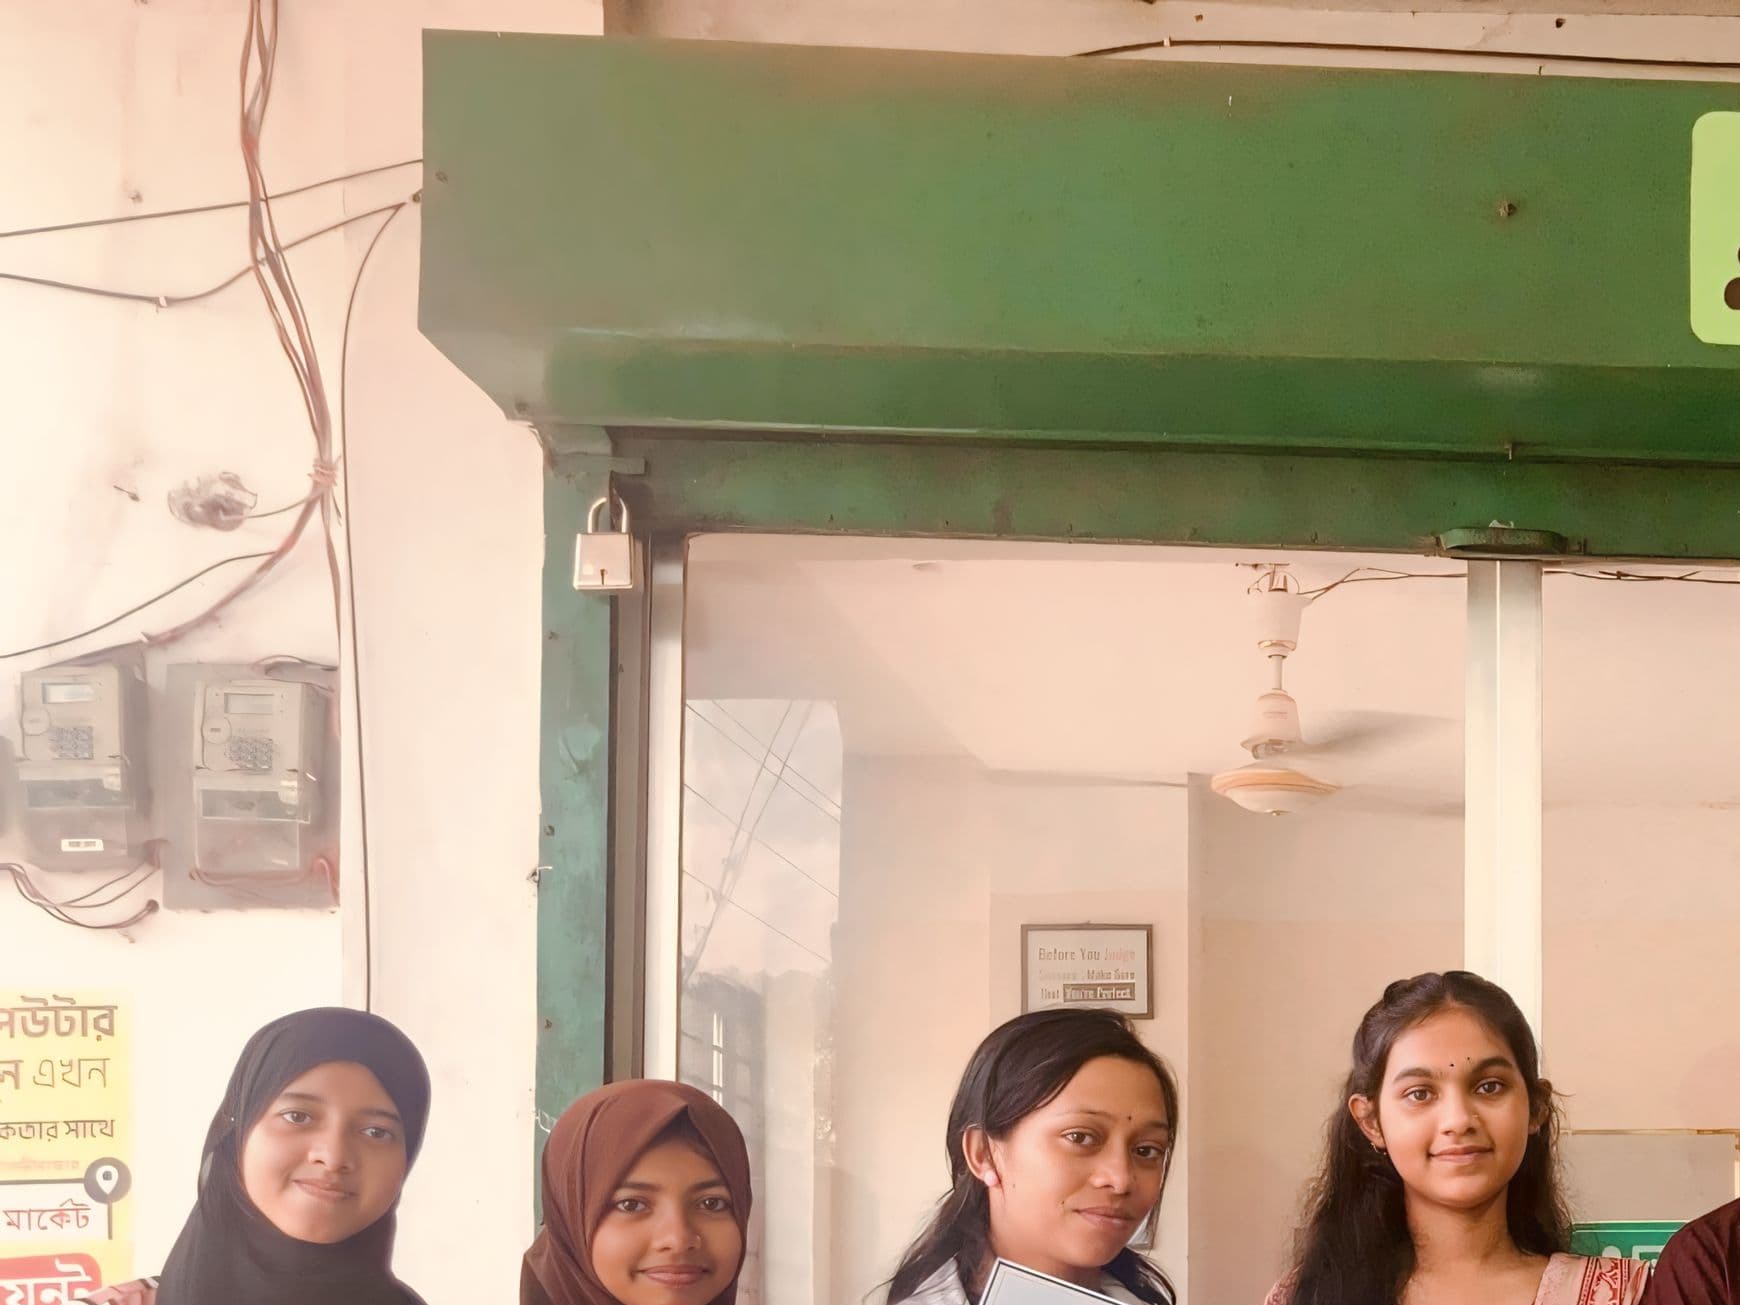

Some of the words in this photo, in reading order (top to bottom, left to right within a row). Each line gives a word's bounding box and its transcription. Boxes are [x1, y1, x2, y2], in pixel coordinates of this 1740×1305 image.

[1039, 948, 1075, 960] Before
[1080, 948, 1100, 960] You
[0, 994, 118, 1042] উটার
[33, 1058, 110, 1088] এখন
[63, 1119, 115, 1139] সাথে
[3, 1198, 91, 1231] মার্কেট
